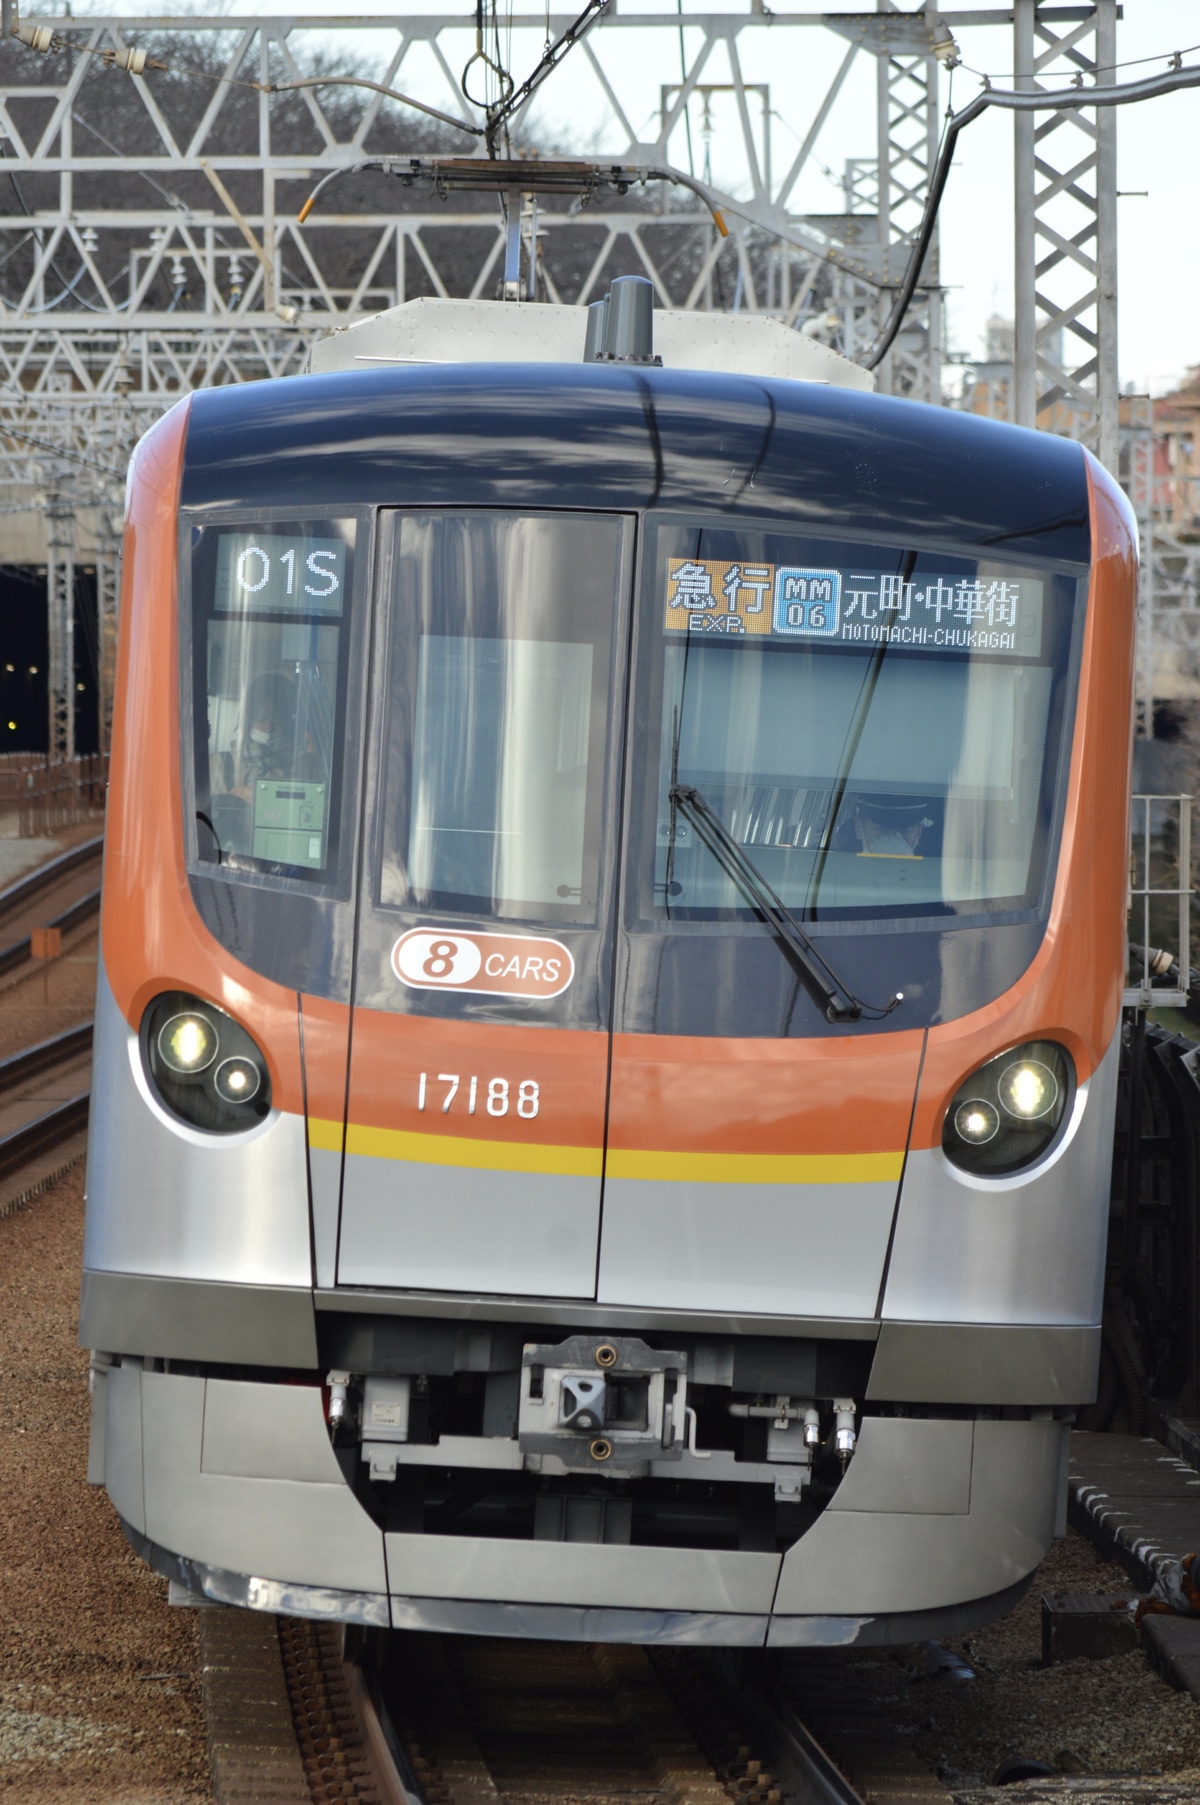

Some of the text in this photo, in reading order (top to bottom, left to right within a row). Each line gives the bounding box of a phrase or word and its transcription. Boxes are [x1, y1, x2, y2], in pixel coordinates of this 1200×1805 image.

[237, 547, 339, 596] 01S
[671, 563, 769, 612] 急行
[786, 578, 831, 601] MM
[689, 614, 745, 634] EXP.
[788, 604, 826, 627] 06
[842, 623, 1015, 649] MOTOMACHI-CHUKAGAI
[422, 940, 561, 982] 8 CARS
[418, 1072, 540, 1119] 17188
